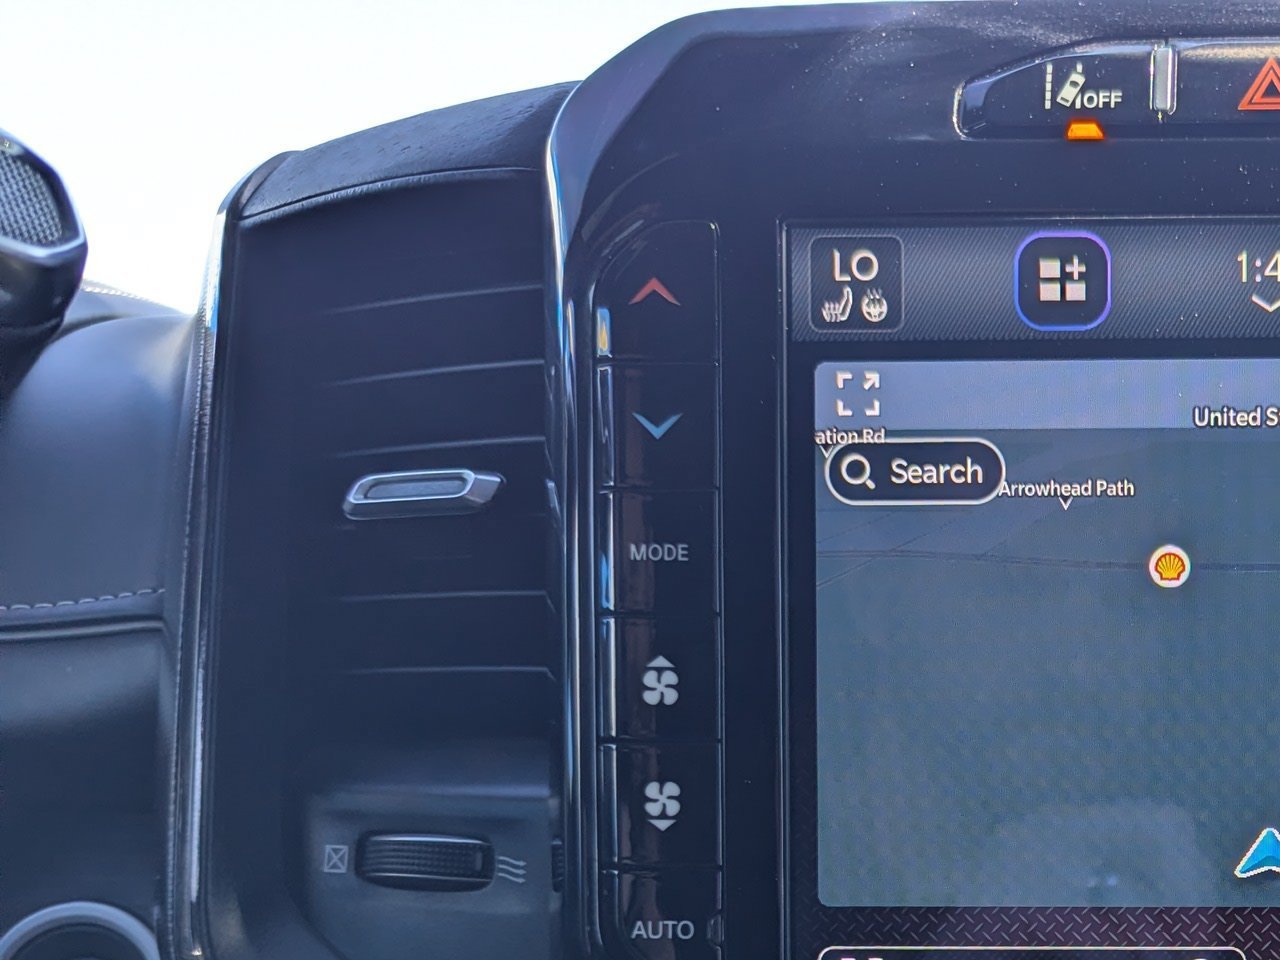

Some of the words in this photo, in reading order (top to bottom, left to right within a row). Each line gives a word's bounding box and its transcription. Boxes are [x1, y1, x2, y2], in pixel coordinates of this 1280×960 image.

[1083, 91, 1122, 108] OFF
[833, 249, 879, 282] LO
[1194, 407, 1262, 427] United
[815, 430, 860, 445] ation
[863, 429, 885, 445] Rd
[890, 457, 984, 485] Search
[999, 479, 1092, 498] Arrowhead
[1096, 480, 1135, 498] Path
[630, 544, 690, 562] MODE
[631, 920, 695, 940] AUTO
